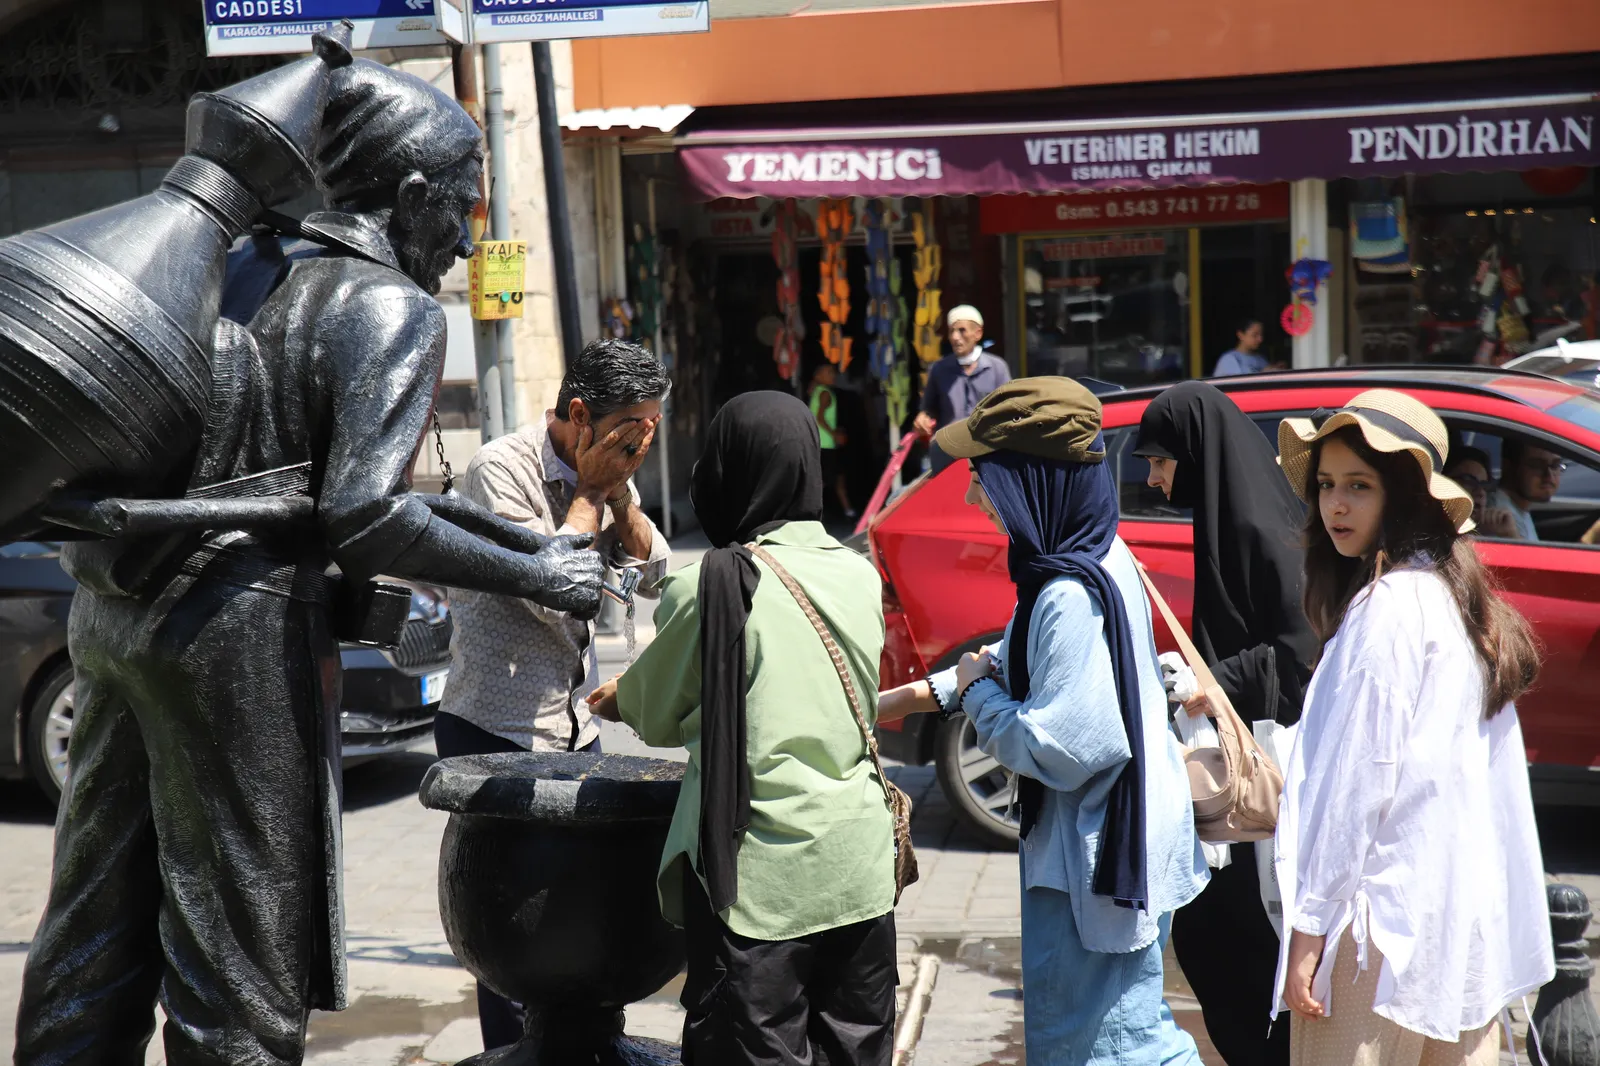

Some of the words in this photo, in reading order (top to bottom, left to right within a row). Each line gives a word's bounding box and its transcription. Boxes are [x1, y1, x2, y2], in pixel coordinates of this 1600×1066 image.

[497, 13, 543, 24] KARAGÖZ
[545, 10, 598, 21] MAHALLESİ
[223, 26, 271, 37] KARAGÖZ
[273, 22, 327, 35] MAHALLESİ
[1348, 115, 1594, 163] PENDİRHAN
[1147, 161, 1212, 180] ÇIKAN
[1056, 203, 1100, 220] Gsm:
[1106, 199, 1159, 217] 0.543
[1166, 197, 1199, 214] 741
[1207, 195, 1229, 212] 77
[1236, 193, 1260, 210] 26
